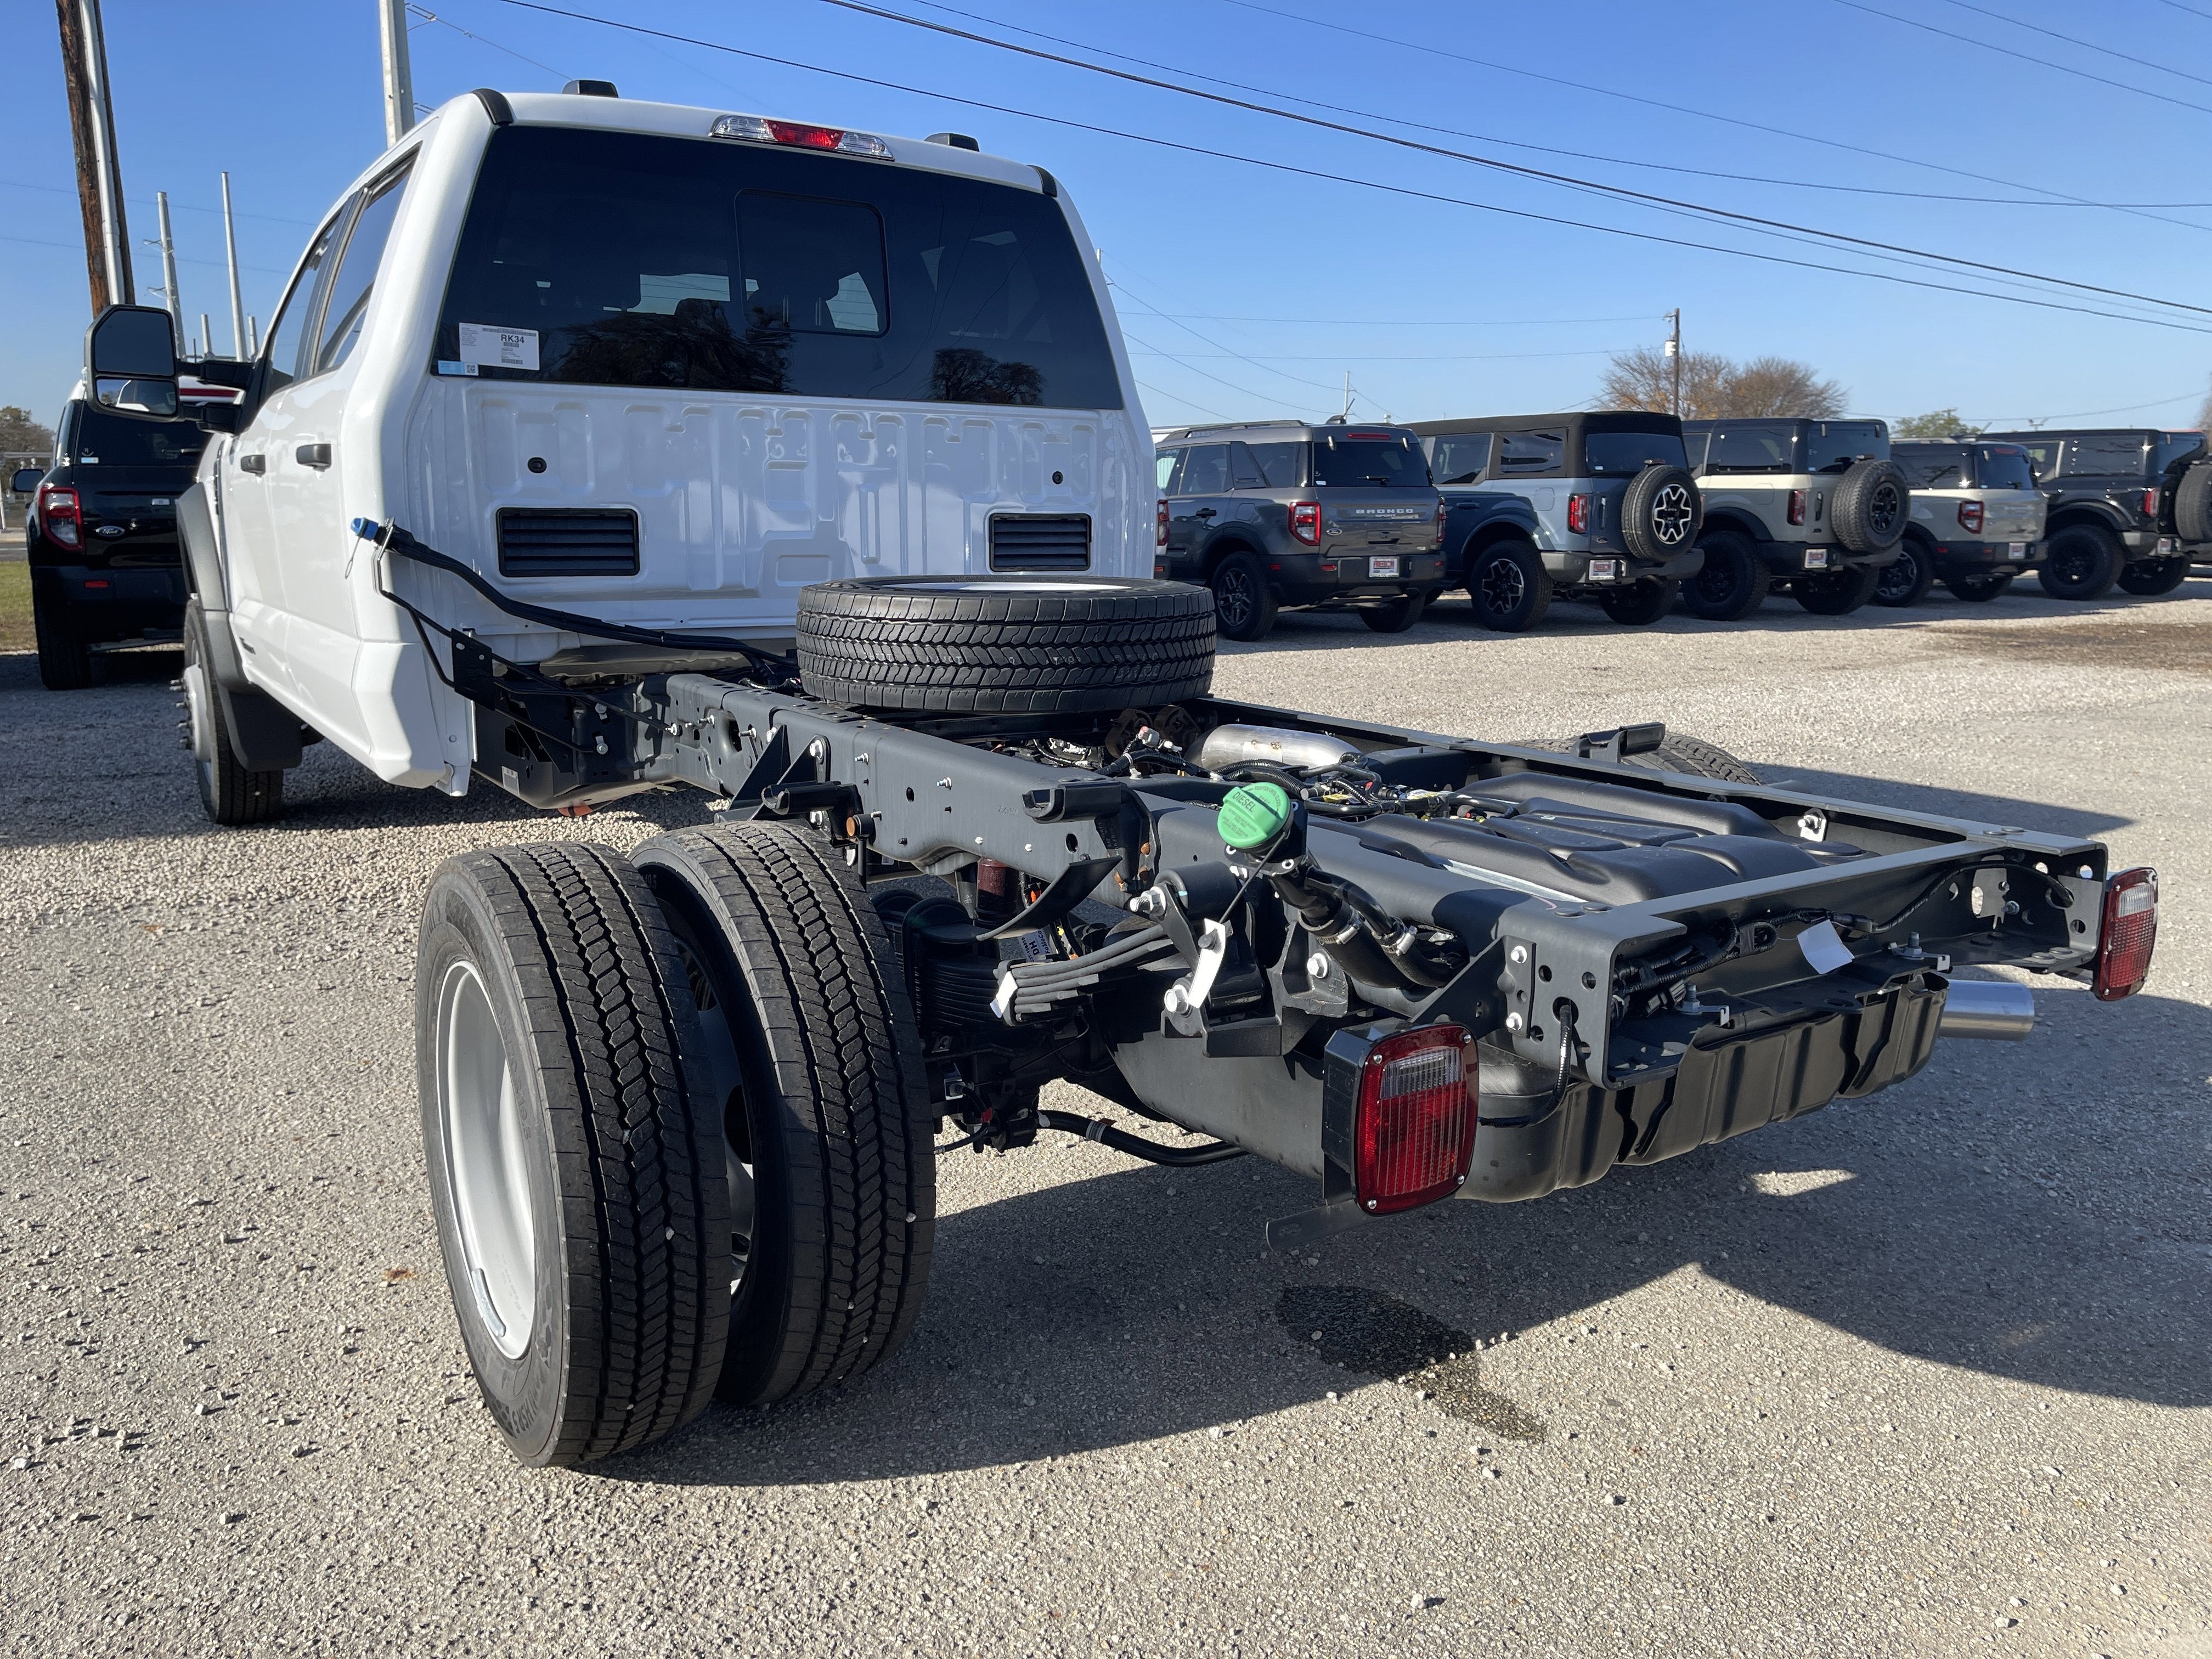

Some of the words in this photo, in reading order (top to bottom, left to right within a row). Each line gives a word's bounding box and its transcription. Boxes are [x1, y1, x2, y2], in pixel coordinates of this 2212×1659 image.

[501, 334, 524, 343] RK34
[1232, 791, 1256, 812] DIESEL
[1029, 940, 1040, 956] DH
[1038, 930, 1051, 954] FoMoCo
